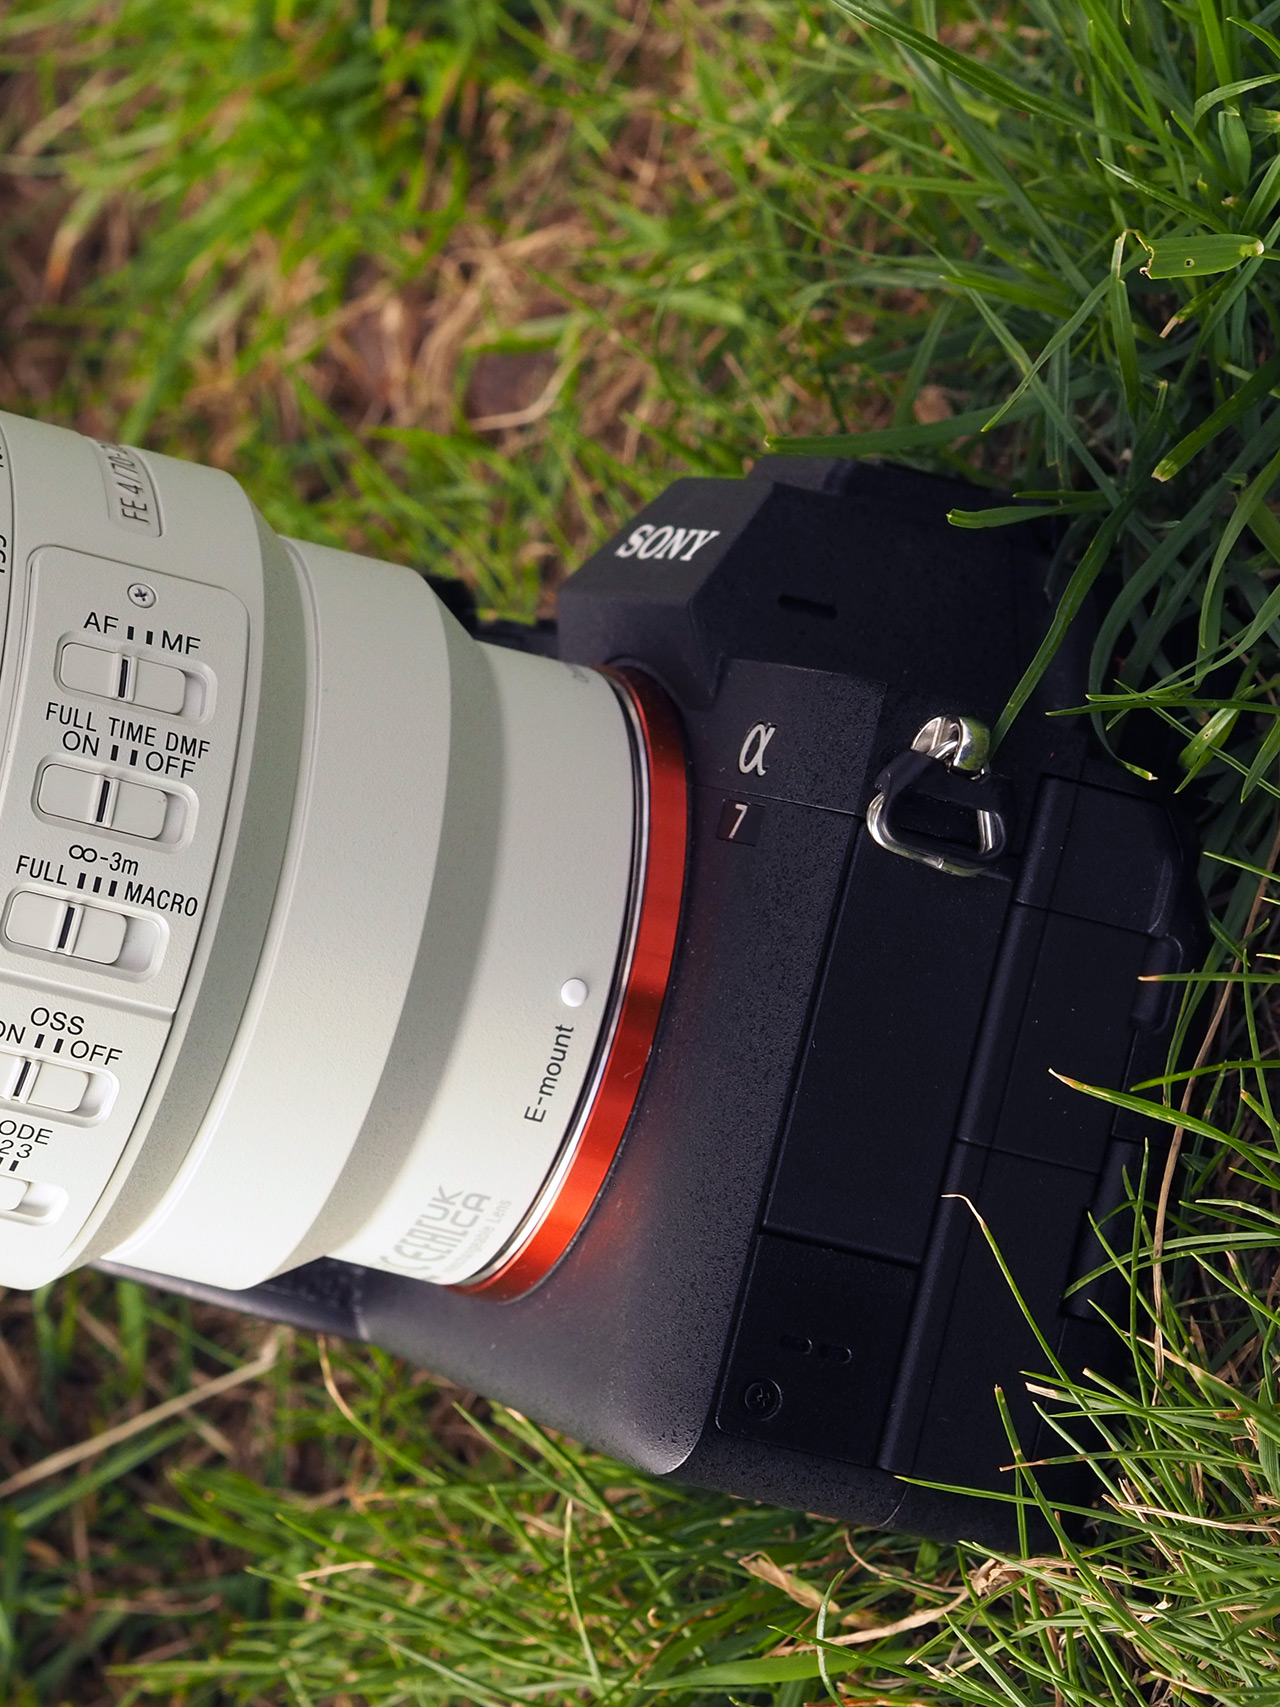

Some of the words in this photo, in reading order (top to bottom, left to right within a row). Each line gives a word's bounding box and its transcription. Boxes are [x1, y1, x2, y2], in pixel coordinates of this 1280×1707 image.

[120, 497, 149, 523] FE
[614, 524, 720, 562] SONY
[83, 611, 119, 634] AF
[161, 633, 201, 655] MF
[45, 702, 97, 733] FULL
[108, 717, 156, 747] TIME
[166, 732, 211, 759] DMF
[62, 731, 100, 757] ON
[146, 751, 196, 779] OFF
[728, 803, 748, 840] 7
[15, 855, 67, 886] FULL
[124, 881, 199, 917] MACRO
[31, 1007, 85, 1035] OSS
[70, 1040, 123, 1066] OFF
[524, 1023, 574, 1123] E-mount
